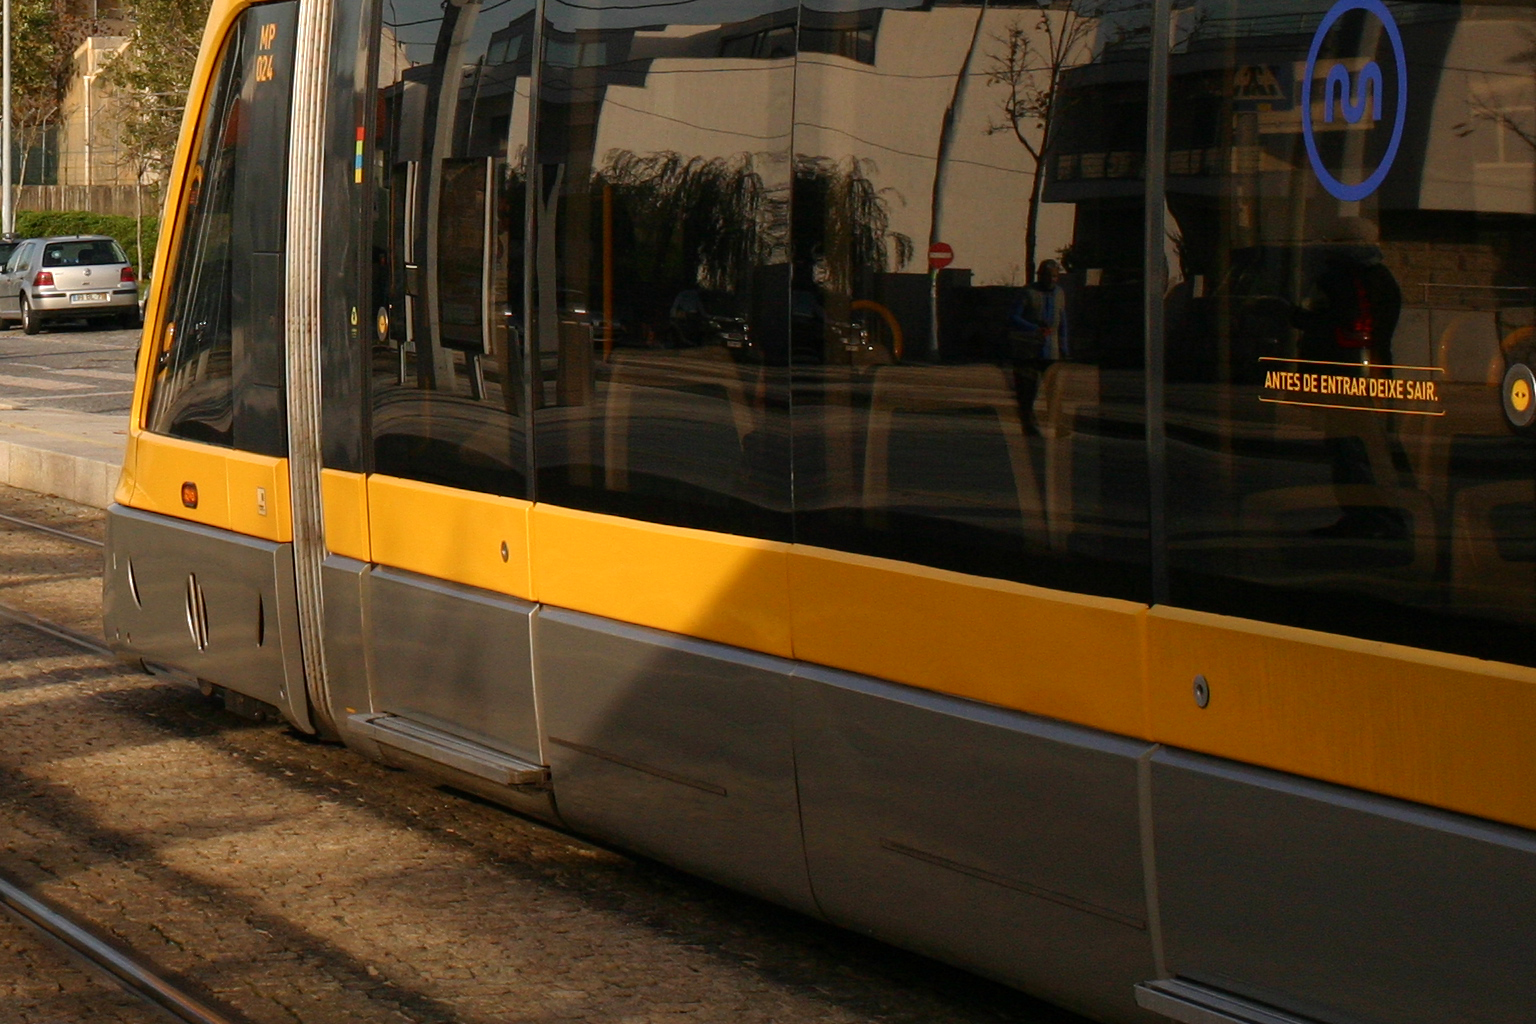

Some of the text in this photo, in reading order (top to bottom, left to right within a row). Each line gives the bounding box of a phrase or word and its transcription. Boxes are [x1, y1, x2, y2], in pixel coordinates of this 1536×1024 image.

[259, 22, 277, 51] MP
[256, 54, 275, 82] 024
[1264, 370, 1439, 402] ANTES DE ENTRAR DEIXE SAIR.
